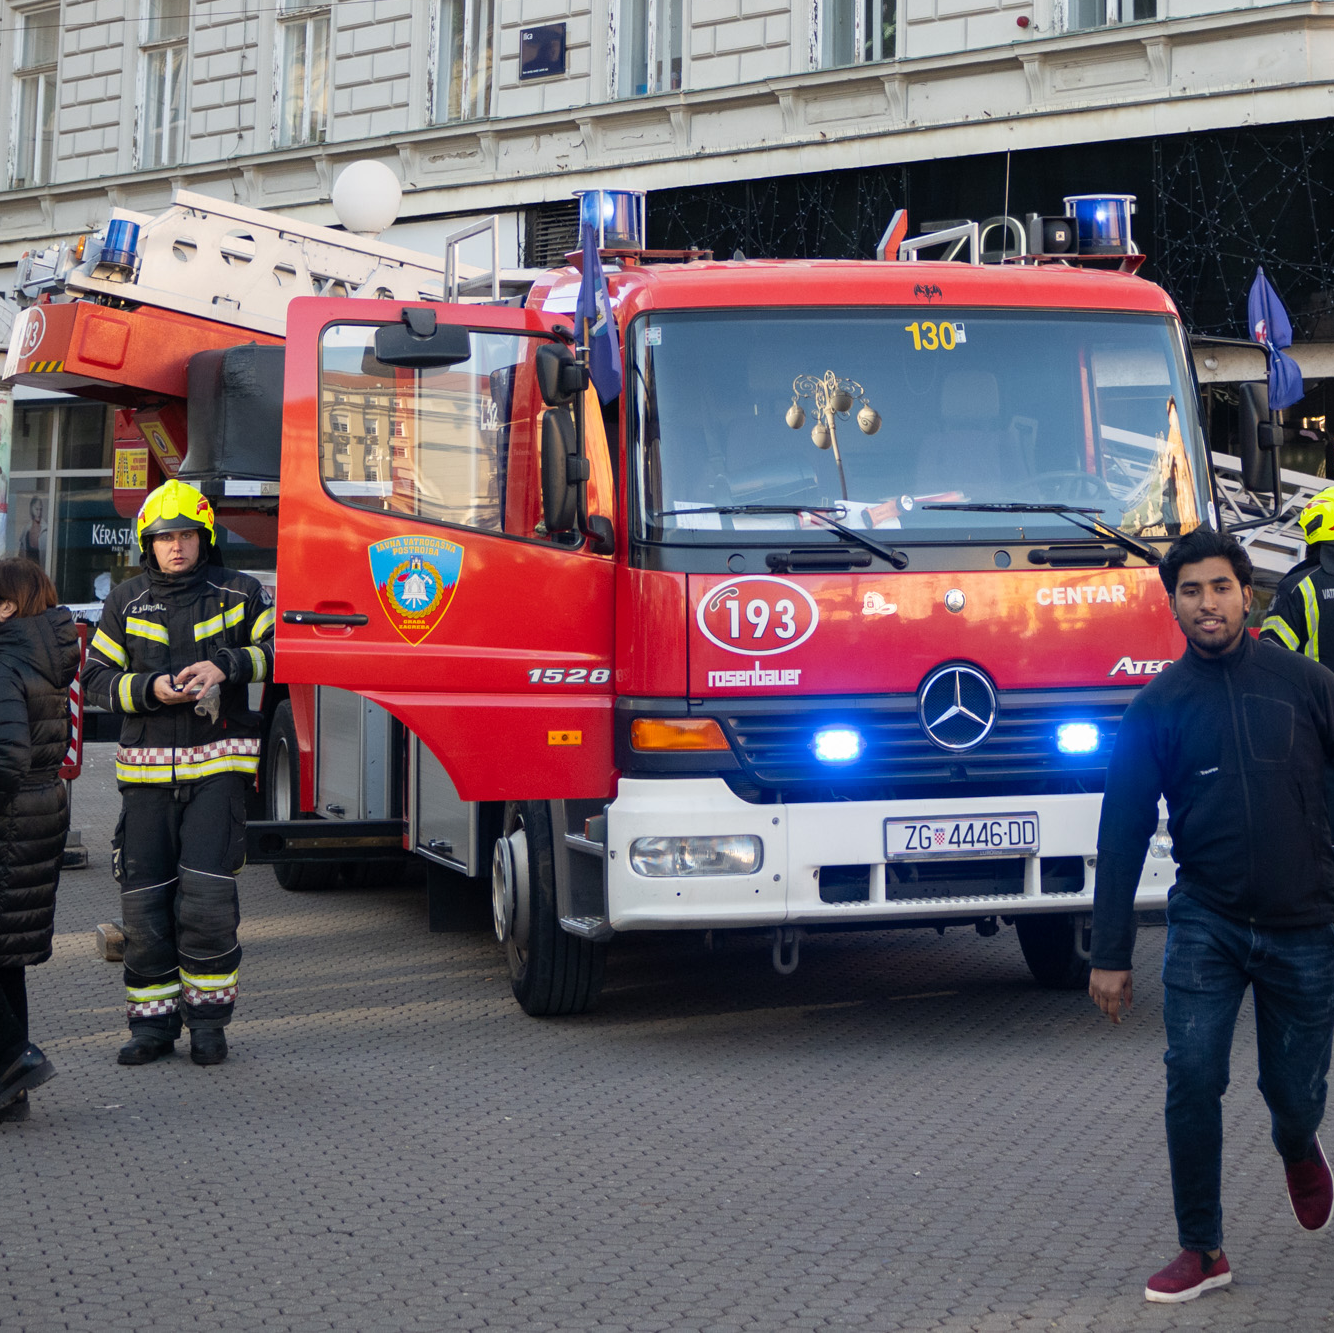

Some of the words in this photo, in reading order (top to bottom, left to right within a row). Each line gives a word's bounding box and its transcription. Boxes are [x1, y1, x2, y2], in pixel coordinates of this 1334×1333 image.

[905, 321, 957, 350] 130
[392, 546, 439, 556] POSTROJBA
[403, 538, 456, 553] VATROGASNA
[1036, 585, 1127, 606] CENTAR
[726, 599, 796, 638] 193
[528, 668, 611, 684] 1528
[708, 661, 801, 687] rosenbauer
[904, 824, 932, 850] ZG
